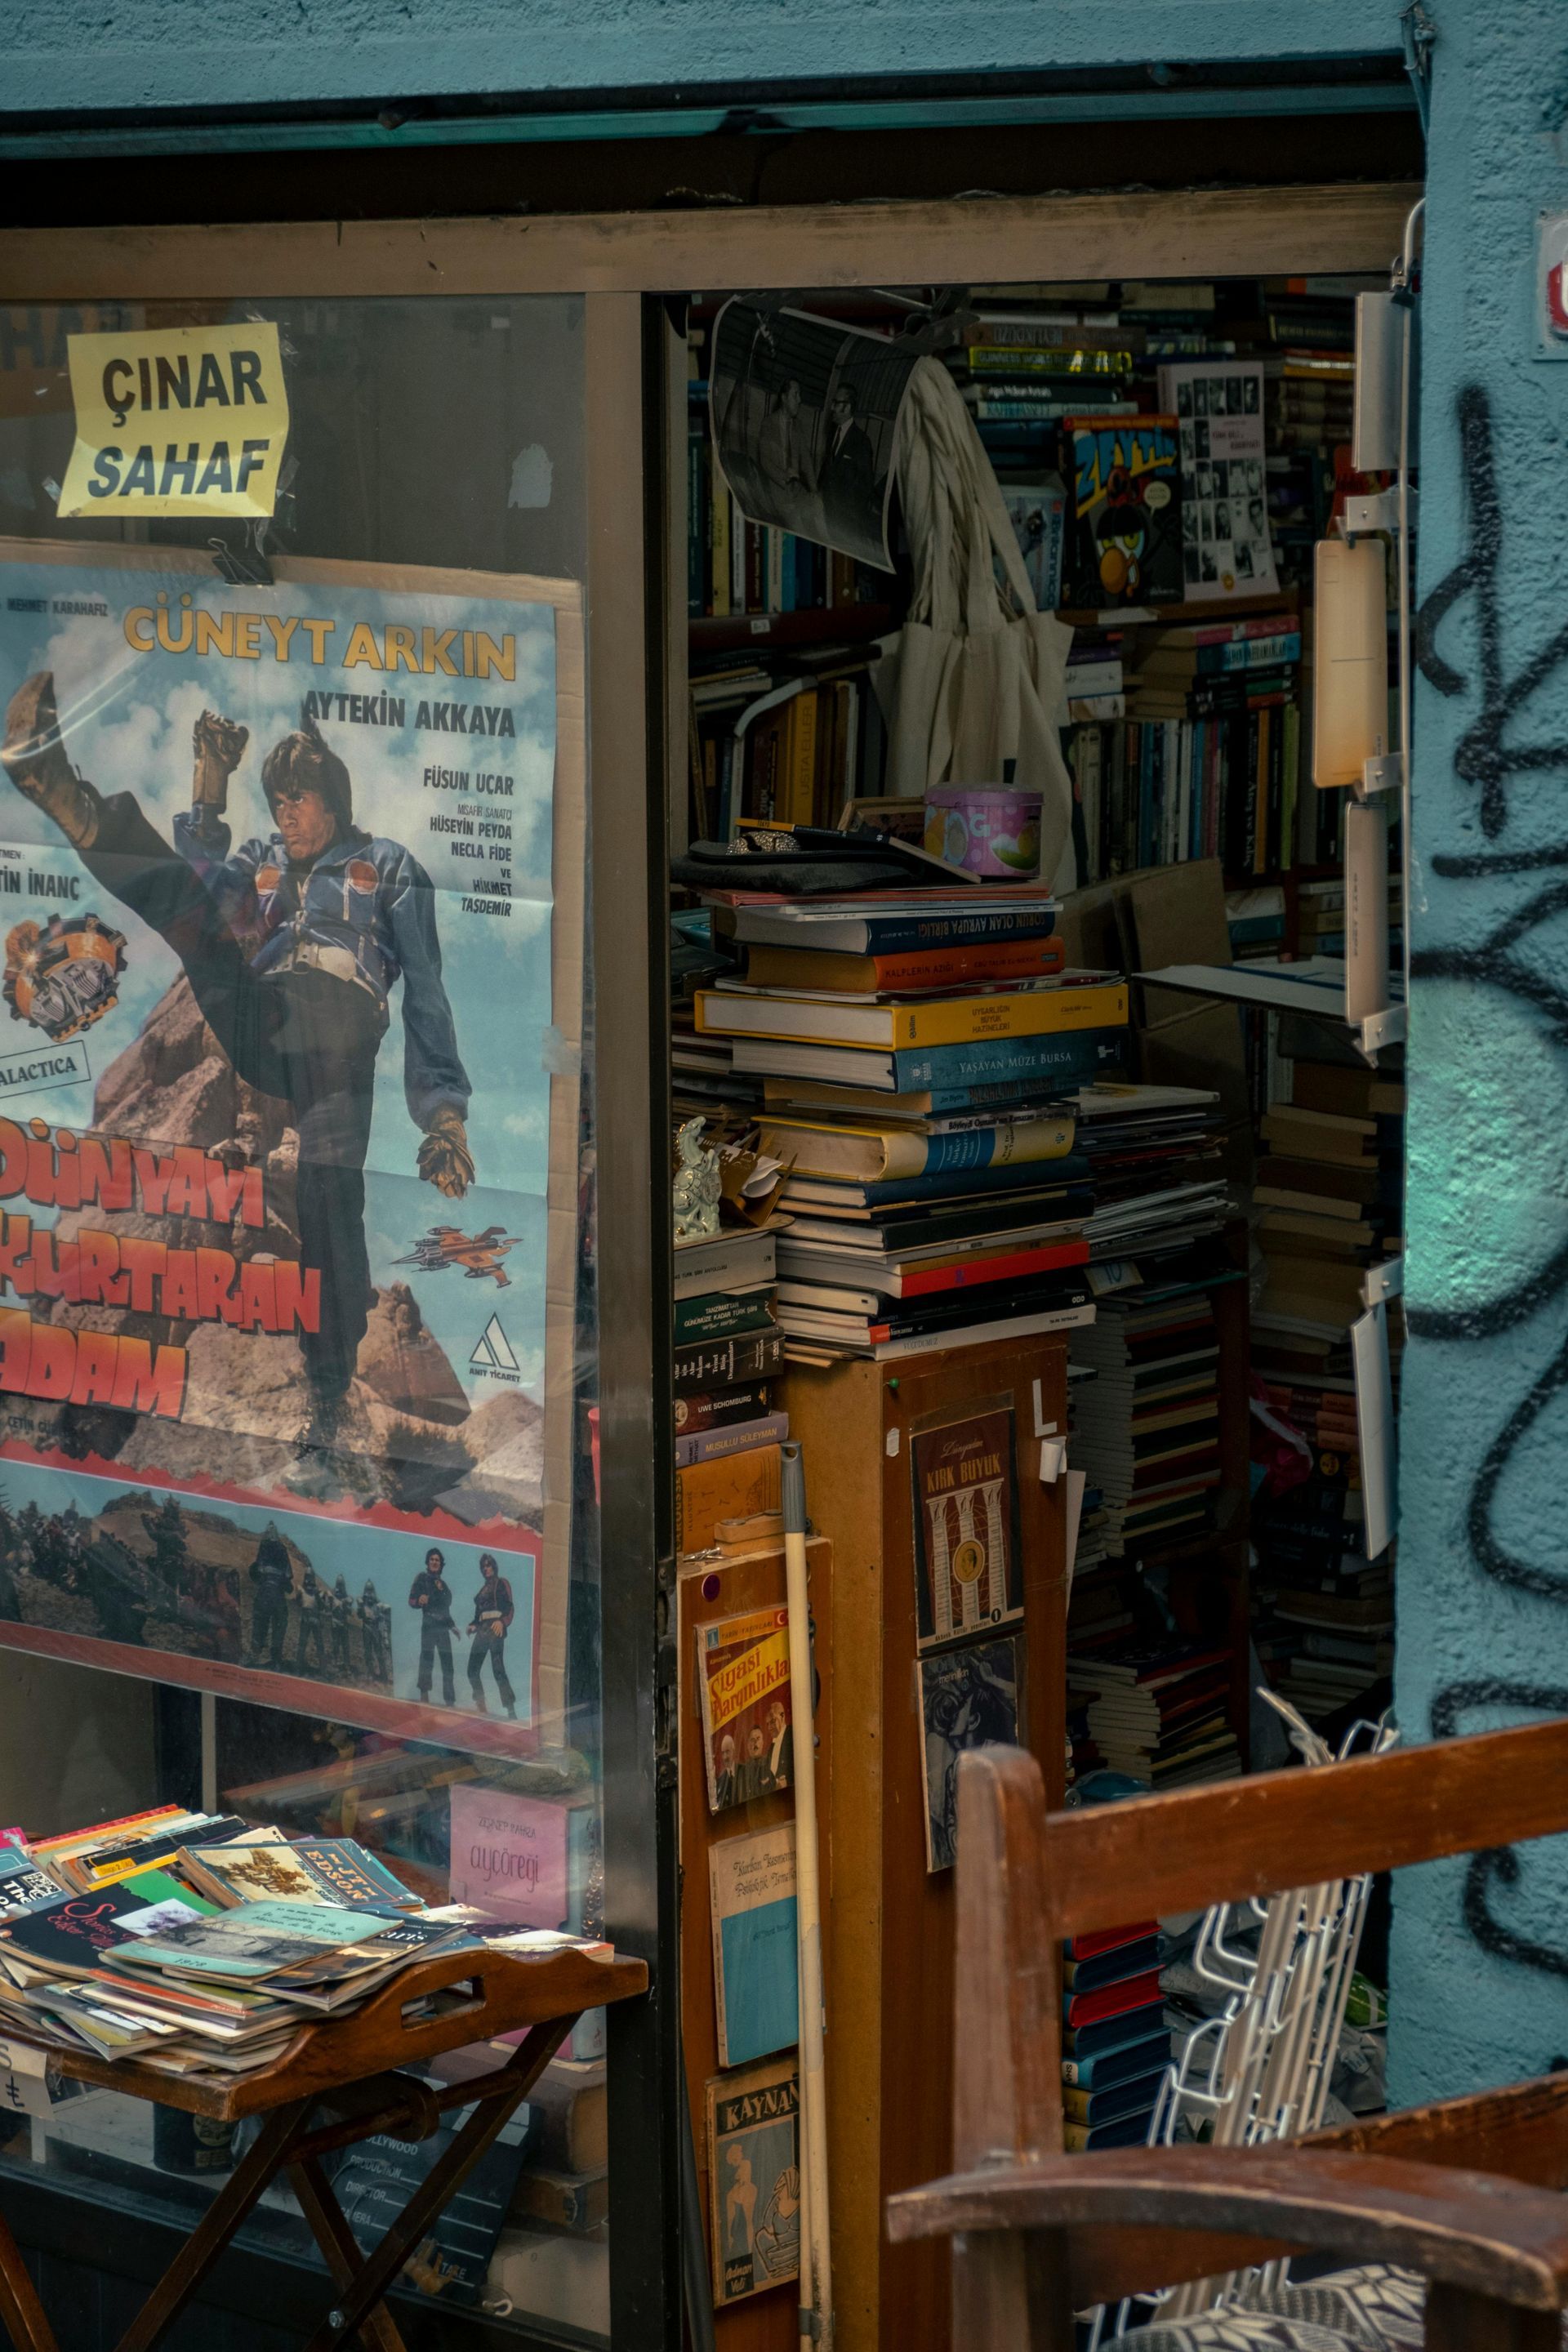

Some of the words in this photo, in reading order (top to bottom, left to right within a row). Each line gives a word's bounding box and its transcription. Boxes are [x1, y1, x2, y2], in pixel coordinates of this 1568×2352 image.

[103, 350, 268, 428] ÇINAR
[88, 439, 270, 498] SAHAF
[7, 599, 49, 613] MEHMET
[53, 600, 108, 617] KARAHAFIZ
[125, 590, 334, 666] CÜNEYT
[342, 623, 515, 681] ARKIN
[303, 688, 405, 727] AYTEKİN
[415, 700, 514, 737] AKKAYA
[423, 765, 469, 791] FÜSUN
[476, 773, 514, 795] UÇAR
[430, 815, 474, 835] HÜSEYİN
[479, 822, 512, 840] PEYDA
[451, 841, 484, 859] NECLA
[489, 844, 511, 862] FİDE
[28, 868, 79, 901] İNANÇ
[501, 868, 510, 878] VE
[472, 878, 511, 897] HİKMET
[461, 898, 511, 916] TAŞDEMİR
[951, 917, 987, 934] AVRUPA
[990, 915, 1014, 930] OLAN
[885, 967, 930, 978] KALPLERİN
[0, 1058, 77, 1087] ALACTICA
[960, 1060, 1004, 1074] YAŞAYAN
[1007, 1056, 1036, 1068] MÜZE
[1040, 1052, 1072, 1065] BURSA
[0, 1209, 321, 1334] KURTARAN
[713, 1312, 732, 1321] KADAR
[470, 1368, 488, 1376] ANIT
[490, 1370, 520, 1383] TİCARET
[697, 1405, 712, 1414] UWE
[713, 1394, 751, 1410] SCHOMBURG
[706, 1437, 737, 1452] MUSULLU
[740, 1427, 777, 1444] SÜLEYMAN
[927, 1468, 956, 1493] KIRK
[960, 1452, 1001, 1483] BÜYÜK
[710, 1647, 760, 1699] Siyasi
[712, 1659, 791, 1724] Dargınlıkla
[305, 1849, 369, 1902] EDSON
[3, 1881, 32, 1904] The
[378, 1930, 427, 1943] aris
[364, 2134, 419, 2156] OLLYWOOD
[350, 2154, 402, 2179] PRODUCTION
